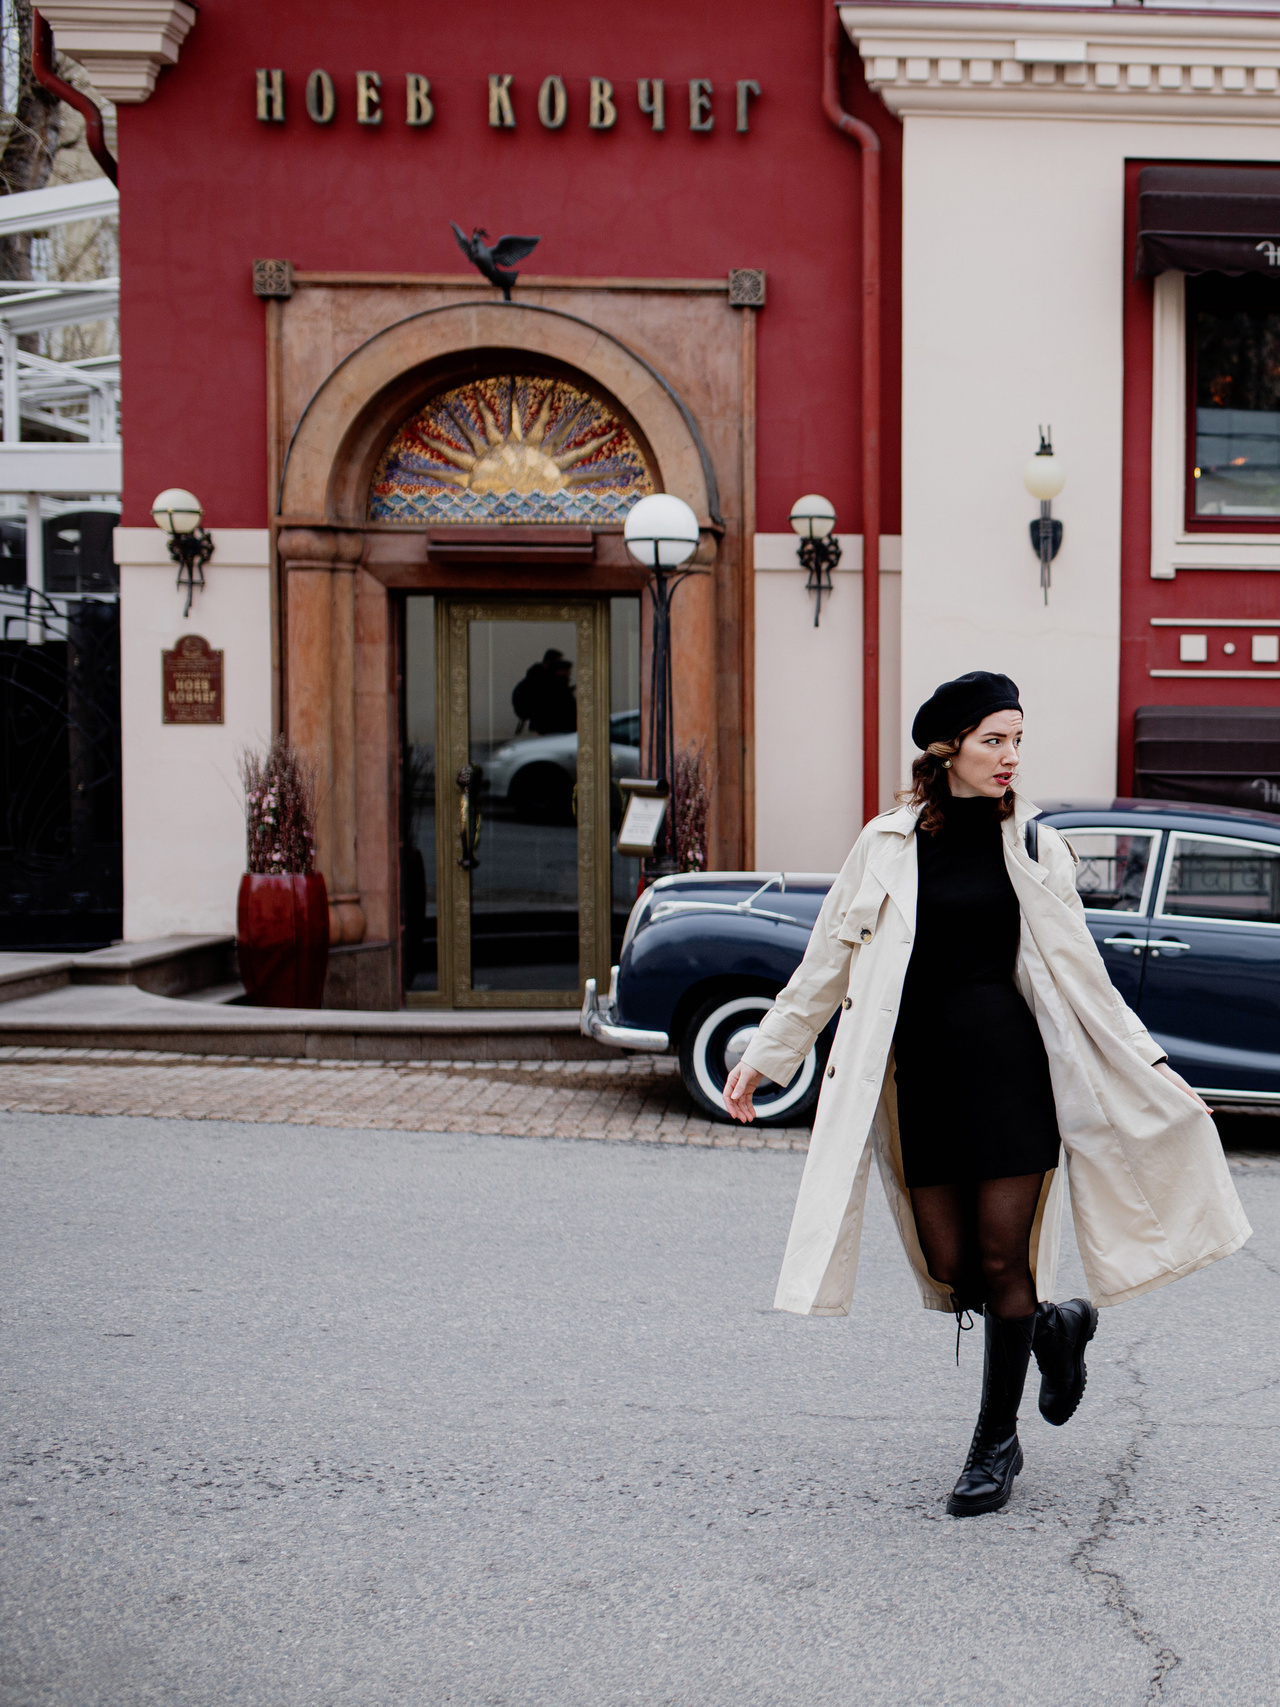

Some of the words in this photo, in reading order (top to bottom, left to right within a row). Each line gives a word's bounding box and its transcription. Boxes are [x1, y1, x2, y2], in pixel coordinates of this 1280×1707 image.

[255, 68, 434, 127] НОЕВ
[487, 73, 762, 133] КОВЧЕГ
[175, 679, 210, 691] НОЕВ
[167, 690, 217, 704] КОВЧЕГ
